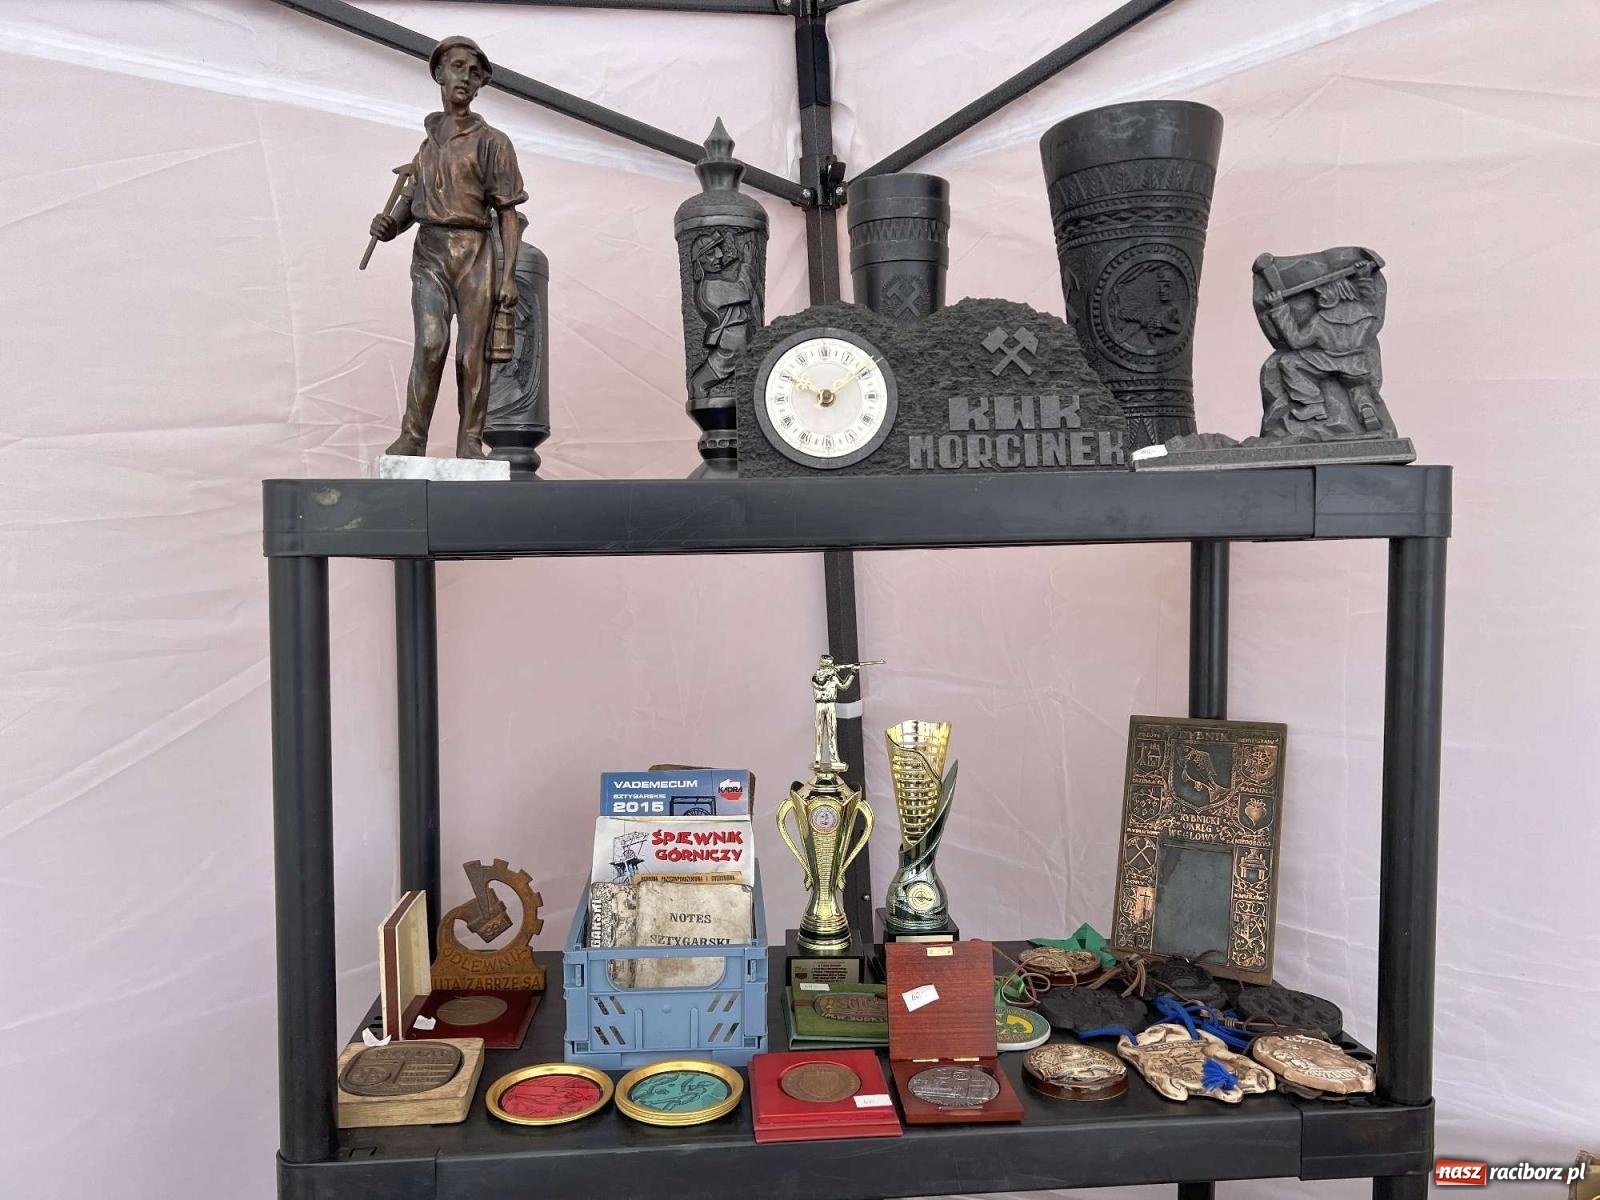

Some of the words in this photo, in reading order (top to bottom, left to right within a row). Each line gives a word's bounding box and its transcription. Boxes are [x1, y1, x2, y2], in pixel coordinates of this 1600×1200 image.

[948, 395, 1081, 431] KWK
[908, 431, 1125, 470] MORCINEK
[613, 780, 698, 789] VADEMECUM
[718, 786, 743, 794] KADRA
[613, 801, 664, 813] 2015
[655, 847, 743, 862] GÓRNICZY
[669, 912, 712, 924] NOTES
[650, 934, 732, 947] SZTYGARSKI
[443, 945, 528, 973] ODLEWNIA
[523, 975, 540, 990] SA
